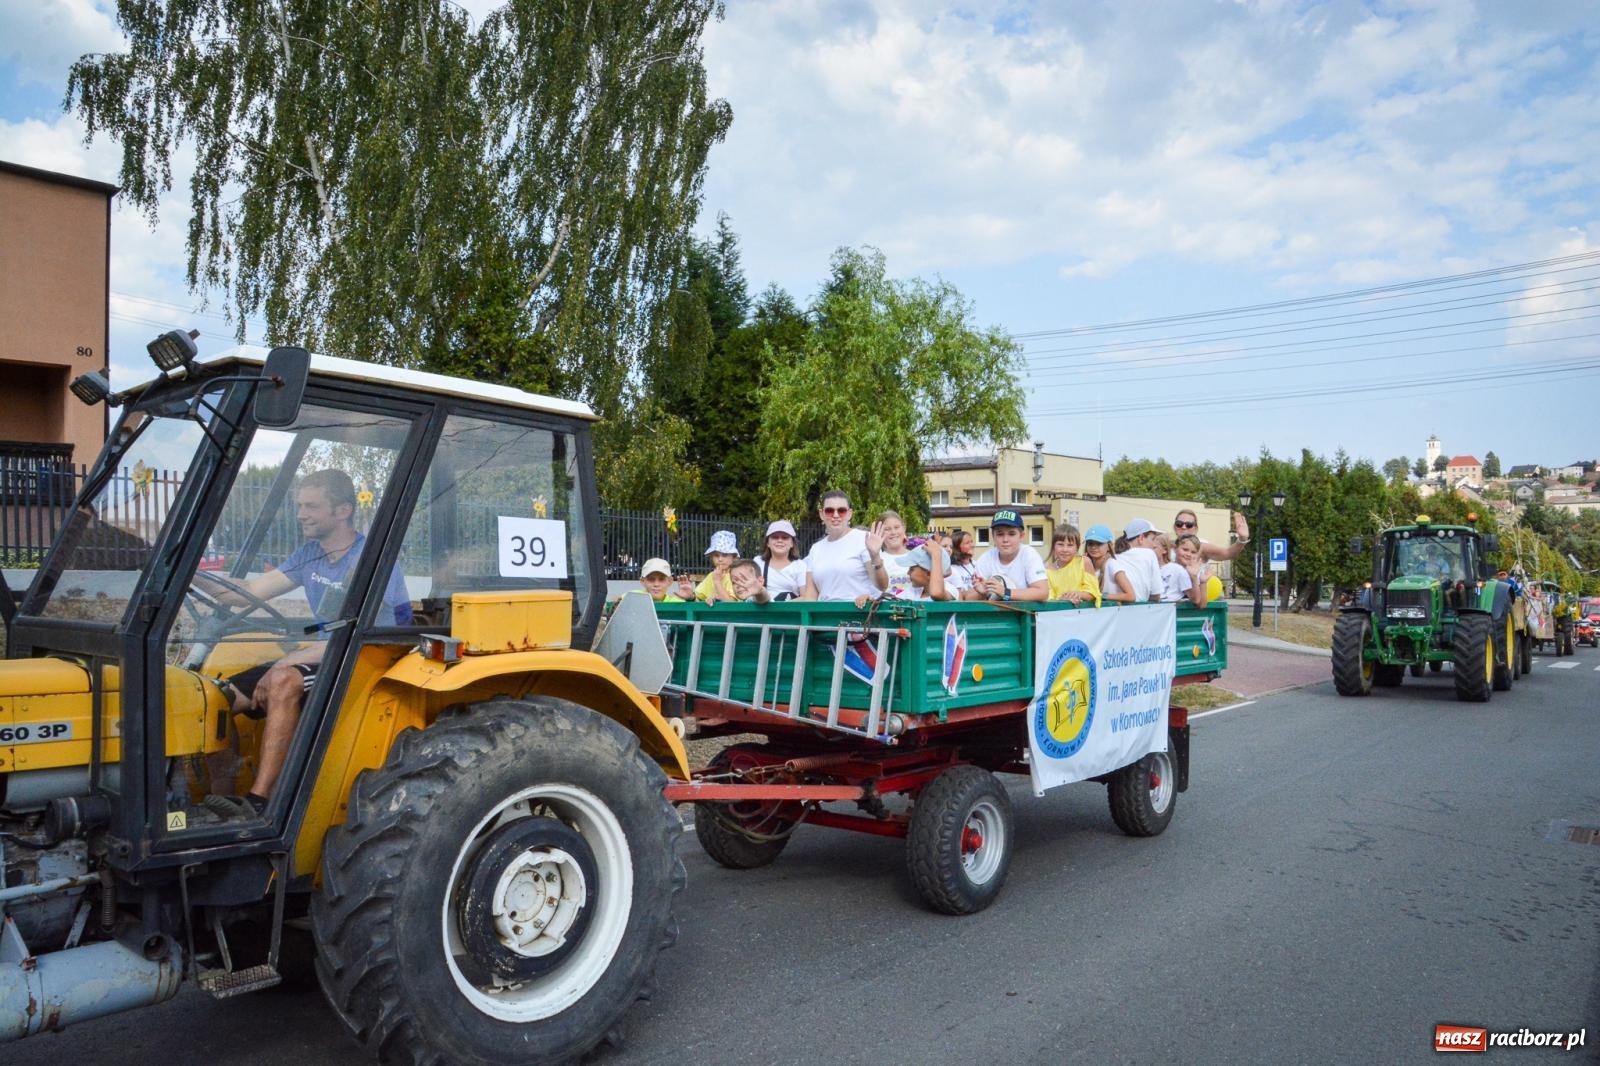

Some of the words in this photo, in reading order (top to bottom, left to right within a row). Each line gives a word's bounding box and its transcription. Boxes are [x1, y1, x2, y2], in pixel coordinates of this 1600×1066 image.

[76, 346, 93, 358] 80
[510, 535, 555, 568] 39.
[1273, 541, 1284, 559] P
[1103, 648, 1128, 670] Szkoła
[1130, 644, 1172, 665] Podstawowa
[1108, 681, 1120, 702] im.
[1121, 680, 1137, 703] Jana
[37, 723, 68, 739] 3P
[1111, 718, 1118, 733] w
